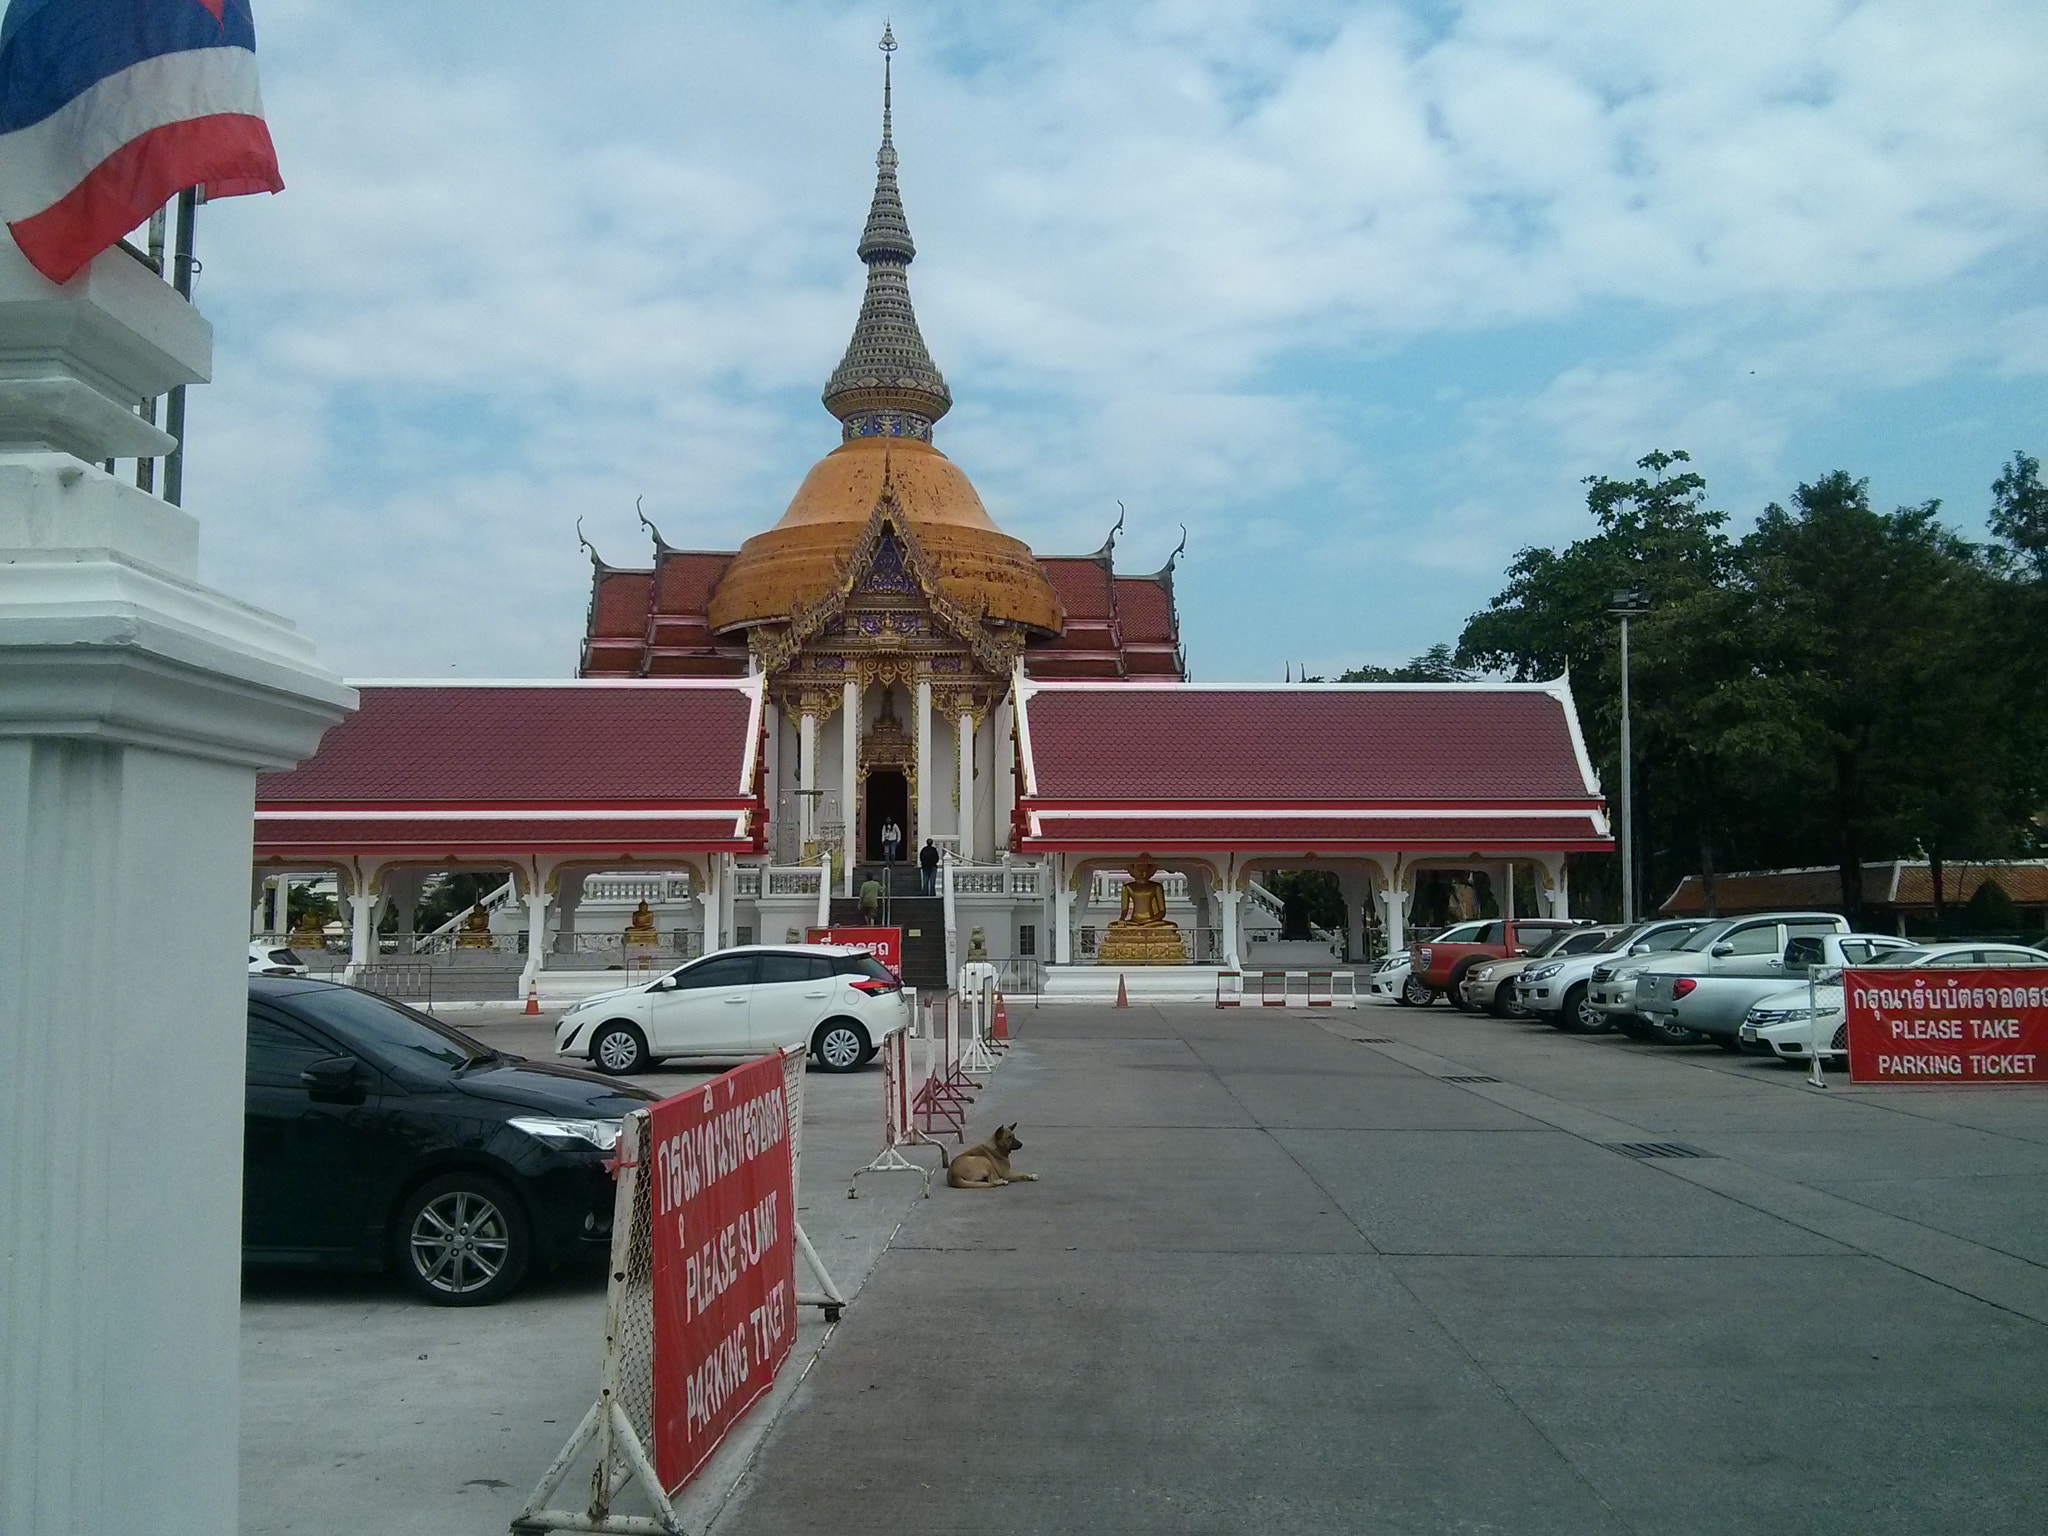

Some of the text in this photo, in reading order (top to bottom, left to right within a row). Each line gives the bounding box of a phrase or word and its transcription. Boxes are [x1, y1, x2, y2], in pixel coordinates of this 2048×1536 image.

[1891, 1019, 2020, 1039] PLEASE TAKE
[1878, 1055, 2037, 1075] PARKING TICKET
[686, 1221, 738, 1324] PLEASE
[686, 1321, 750, 1443] PARKING
